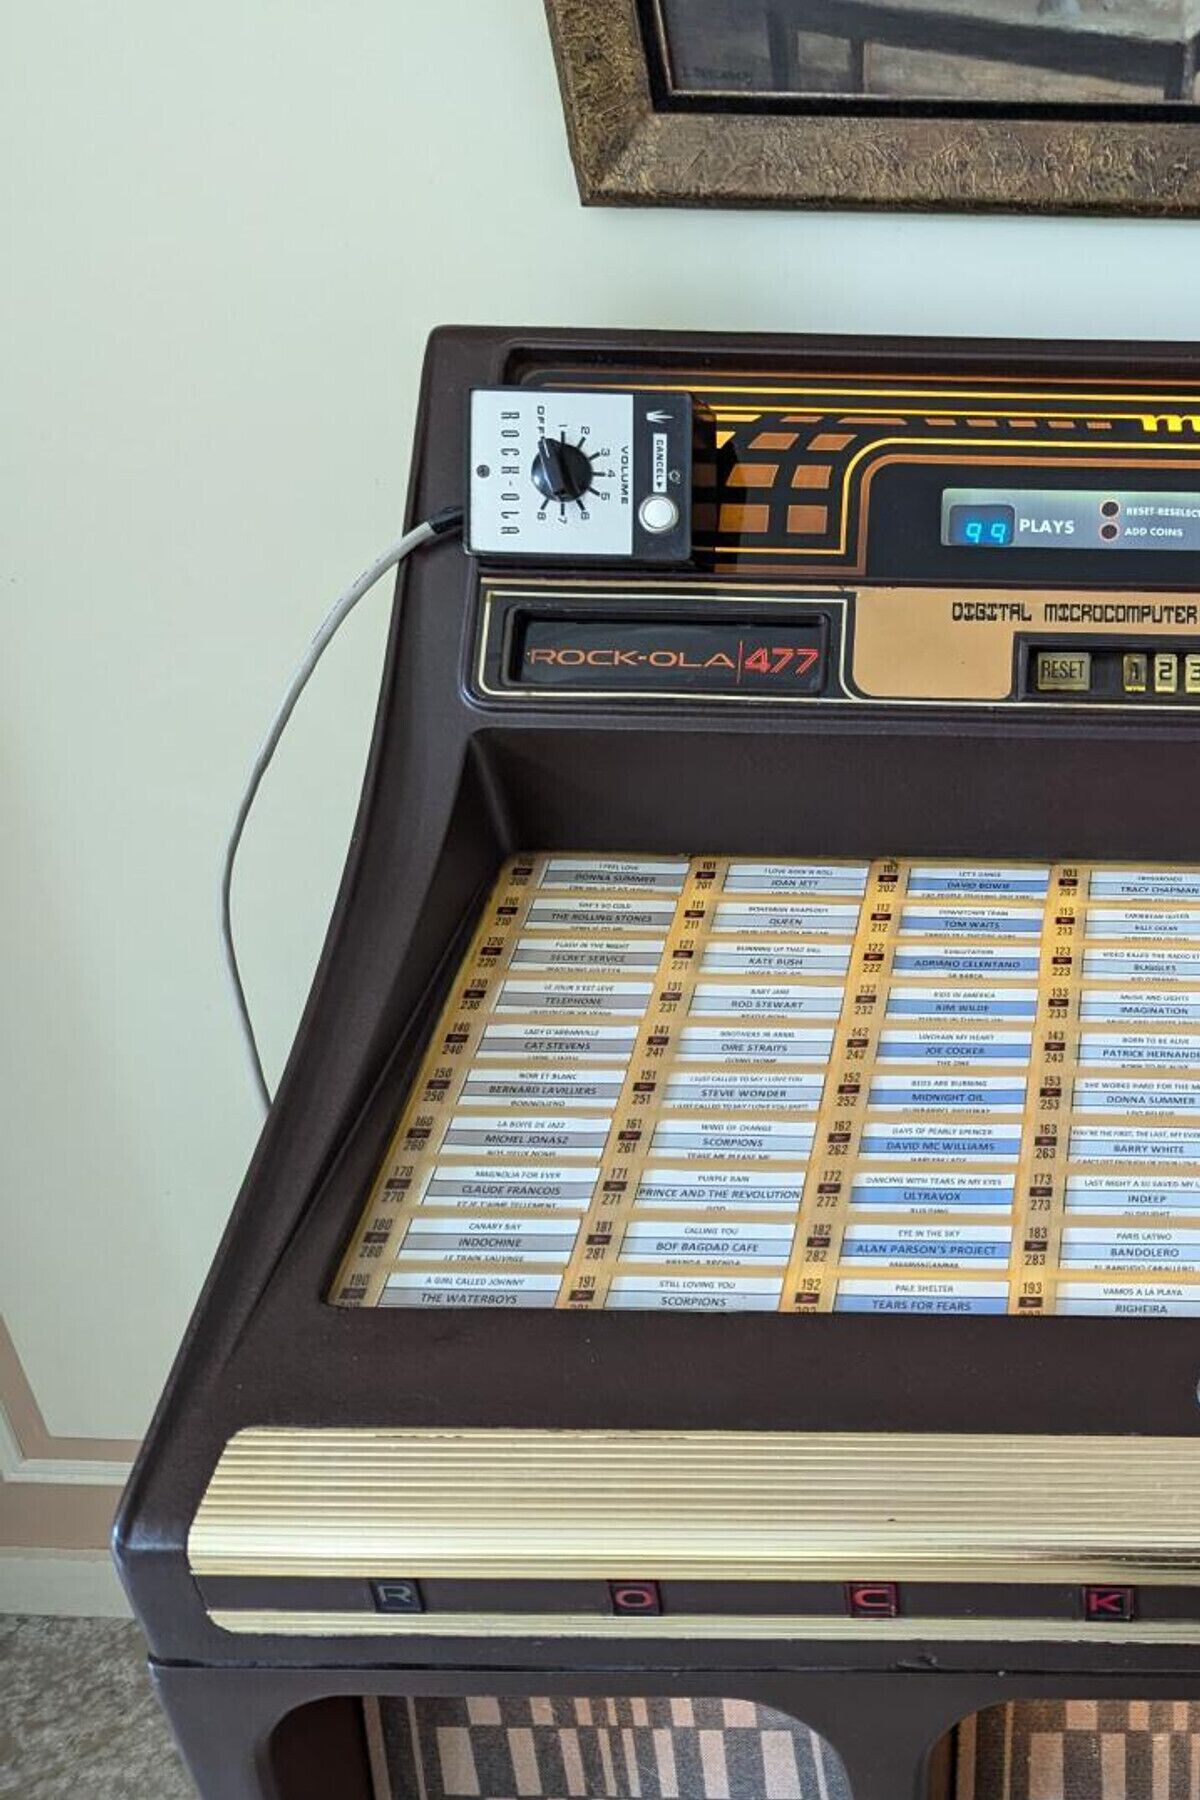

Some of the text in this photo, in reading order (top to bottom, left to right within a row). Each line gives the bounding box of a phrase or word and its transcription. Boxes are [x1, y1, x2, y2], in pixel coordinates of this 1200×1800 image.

[656, 439, 664, 481] CANCEL
[620, 445, 629, 506] VOLUME
[1019, 519, 1075, 534] PLAYS
[1124, 528, 1183, 537] ADD COINS
[952, 602, 1032, 622] DIGITAL
[1045, 603, 1198, 624] MICROCOMPUTER
[744, 648, 818, 673] 477
[1041, 660, 1085, 679] RESET
[1160, 662, 1173, 680] 2
[755, 1001, 803, 1009] STEWART
[548, 1042, 591, 1050] STEVENS
[738, 1090, 786, 1098] WONDER
[1149, 1096, 1195, 1104] SUMMER
[484, 1134, 526, 1144] MICHEL
[702, 1138, 763, 1147] SCORPIONS
[1113, 1145, 1184, 1154] BARRY WHITE
[461, 1186, 503, 1194] CLAUDE
[639, 1189, 800, 1199] PRINCE AND THE REVOLUTION
[904, 1192, 960, 1201] ULTRAVOX
[458, 1238, 522, 1247] INDOCHINE
[656, 1242, 758, 1252] BOF BAGDAD CAFE
[856, 1244, 890, 1253] ALAN
[951, 1246, 997, 1255] PROJECT
[1110, 1248, 1180, 1257] BANDOLERO
[1022, 1282, 1042, 1294] 193
[1103, 1288, 1133, 1296] VAMOS
[420, 1294, 518, 1304] THE WATERBOYS
[661, 1297, 727, 1306] SCORPIONS
[872, 1300, 971, 1311] TEARS FOR FEARS
[1115, 1304, 1168, 1314] RIGHEIRA
[377, 1586, 411, 1603] R
[616, 1590, 652, 1607] O
[1090, 1592, 1121, 1612] K
